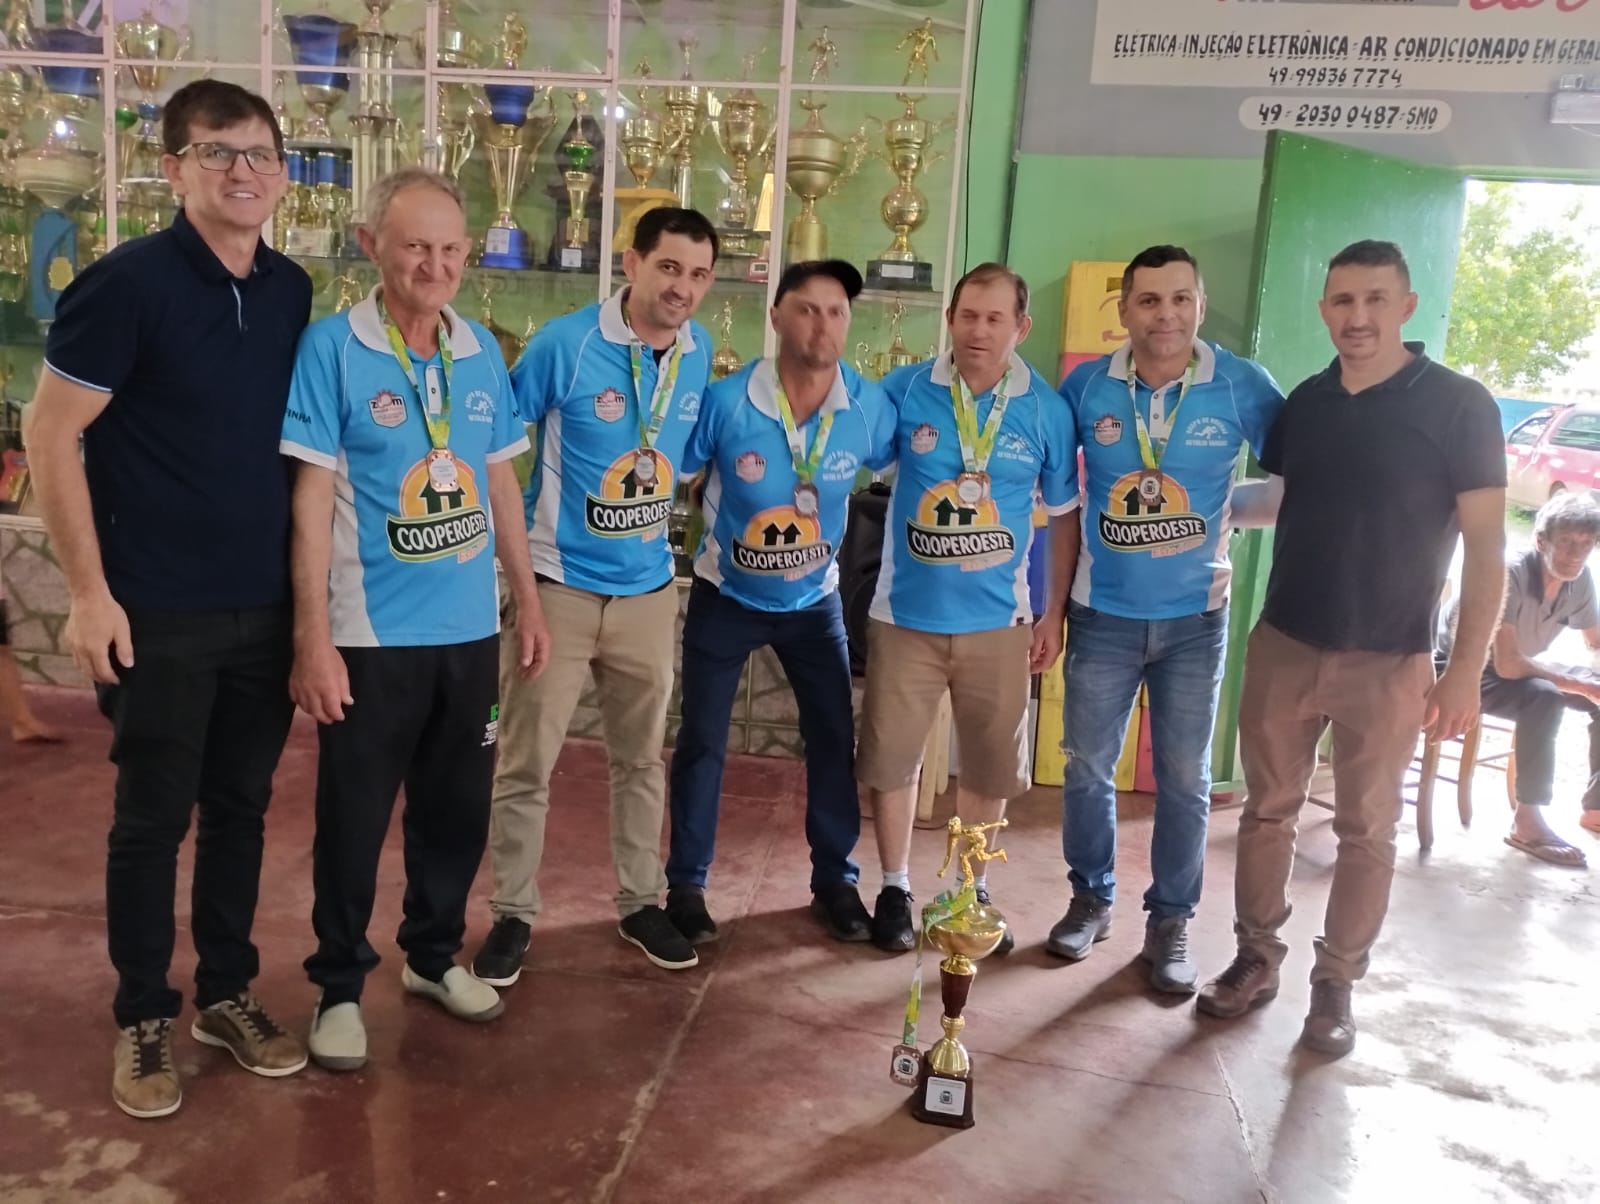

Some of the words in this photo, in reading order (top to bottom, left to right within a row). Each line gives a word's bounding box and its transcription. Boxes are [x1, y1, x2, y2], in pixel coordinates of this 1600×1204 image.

[1359, 36, 1388, 61] AR
[1394, 37, 1530, 63] CONDICIONADO
[1532, 38, 1557, 63] EM
[1352, 68, 1402, 88] 7774
[1258, 103, 1283, 125] 49
[1295, 104, 1341, 127] 2030
[593, 501, 672, 529] COOPEROES
[397, 513, 488, 551] COOPEROESTE
[911, 530, 1011, 556] COOPEROESTE
[1102, 518, 1202, 544] COOPEROESTE
